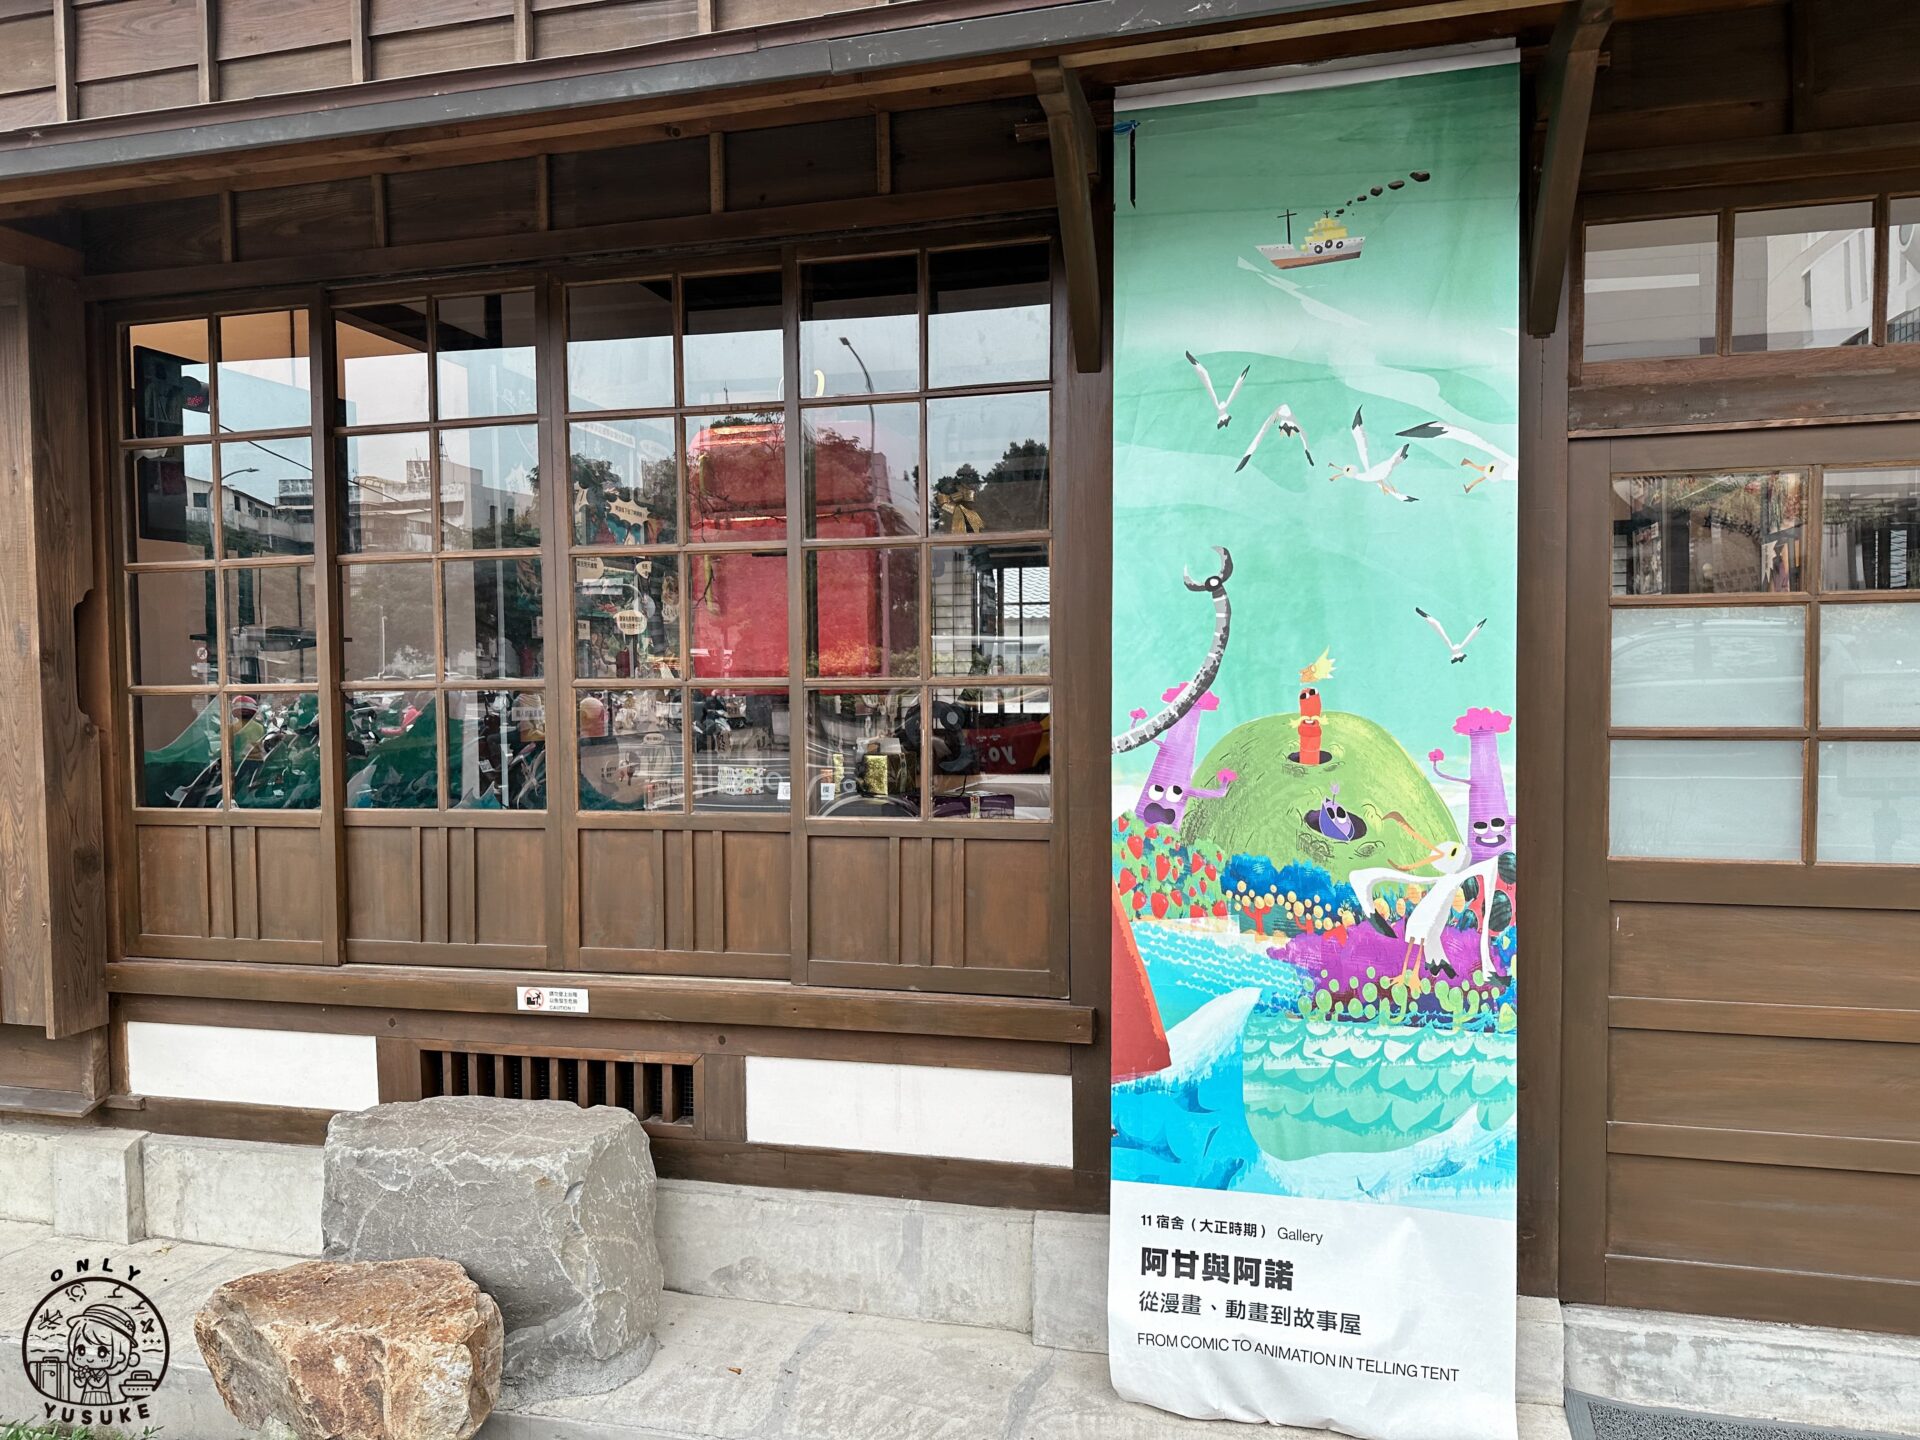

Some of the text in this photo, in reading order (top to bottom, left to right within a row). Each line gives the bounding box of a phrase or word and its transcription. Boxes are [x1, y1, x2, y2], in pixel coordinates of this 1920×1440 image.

[1277, 1227, 1323, 1246] Gallery
[1141, 1247, 1294, 1291] 阿甘與阿諾
[1138, 1290, 1361, 1335] 從漫畫、動畫到故事屋
[1137, 1332, 1460, 1382] FROM COMIC TO ANIMATION IN TELLING TENT
